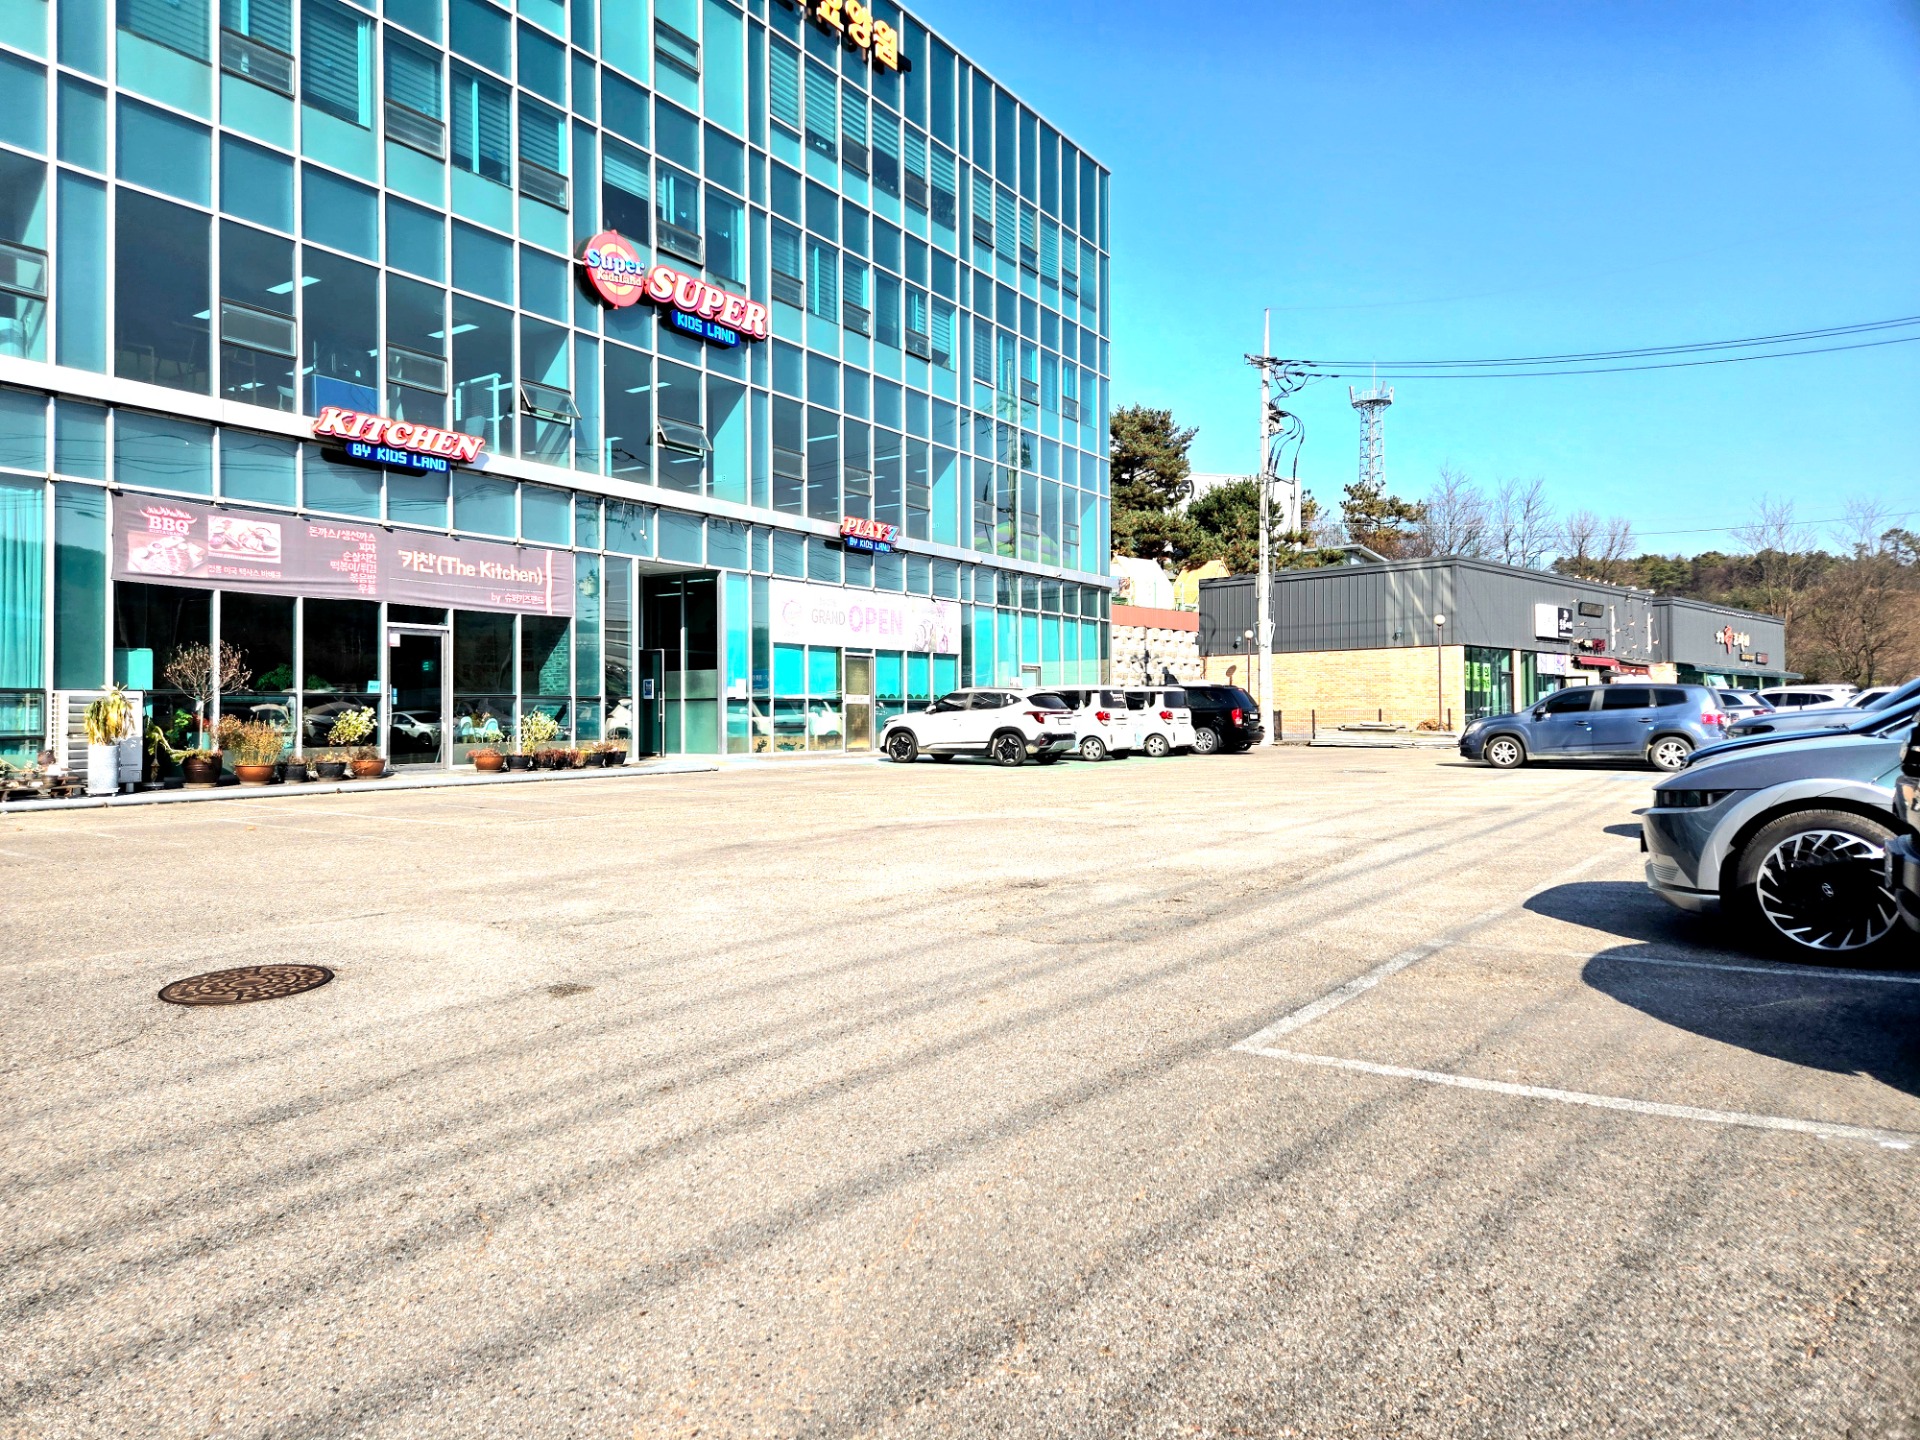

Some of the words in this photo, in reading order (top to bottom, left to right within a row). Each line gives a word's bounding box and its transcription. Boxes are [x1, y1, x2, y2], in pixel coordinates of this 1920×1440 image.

[587, 249, 646, 276] Super
[650, 266, 766, 336] SUPER
[677, 312, 703, 333] KIDS
[706, 322, 736, 345] LAND
[316, 407, 484, 460] KITCHEN
[352, 443, 371, 458] BY
[377, 447, 407, 464] KIDS
[413, 455, 447, 471] LAND
[149, 516, 190, 536] BBQ
[343, 551, 377, 563] 순살치킨
[849, 537, 858, 546] BY
[859, 539, 873, 549] KIDS
[875, 543, 891, 552] LAND
[224, 566, 238, 576] 미국
[479, 561, 543, 585] Kitchen)
[491, 592, 501, 605] by
[811, 608, 846, 626] GRAND
[848, 605, 903, 635] OPEN
